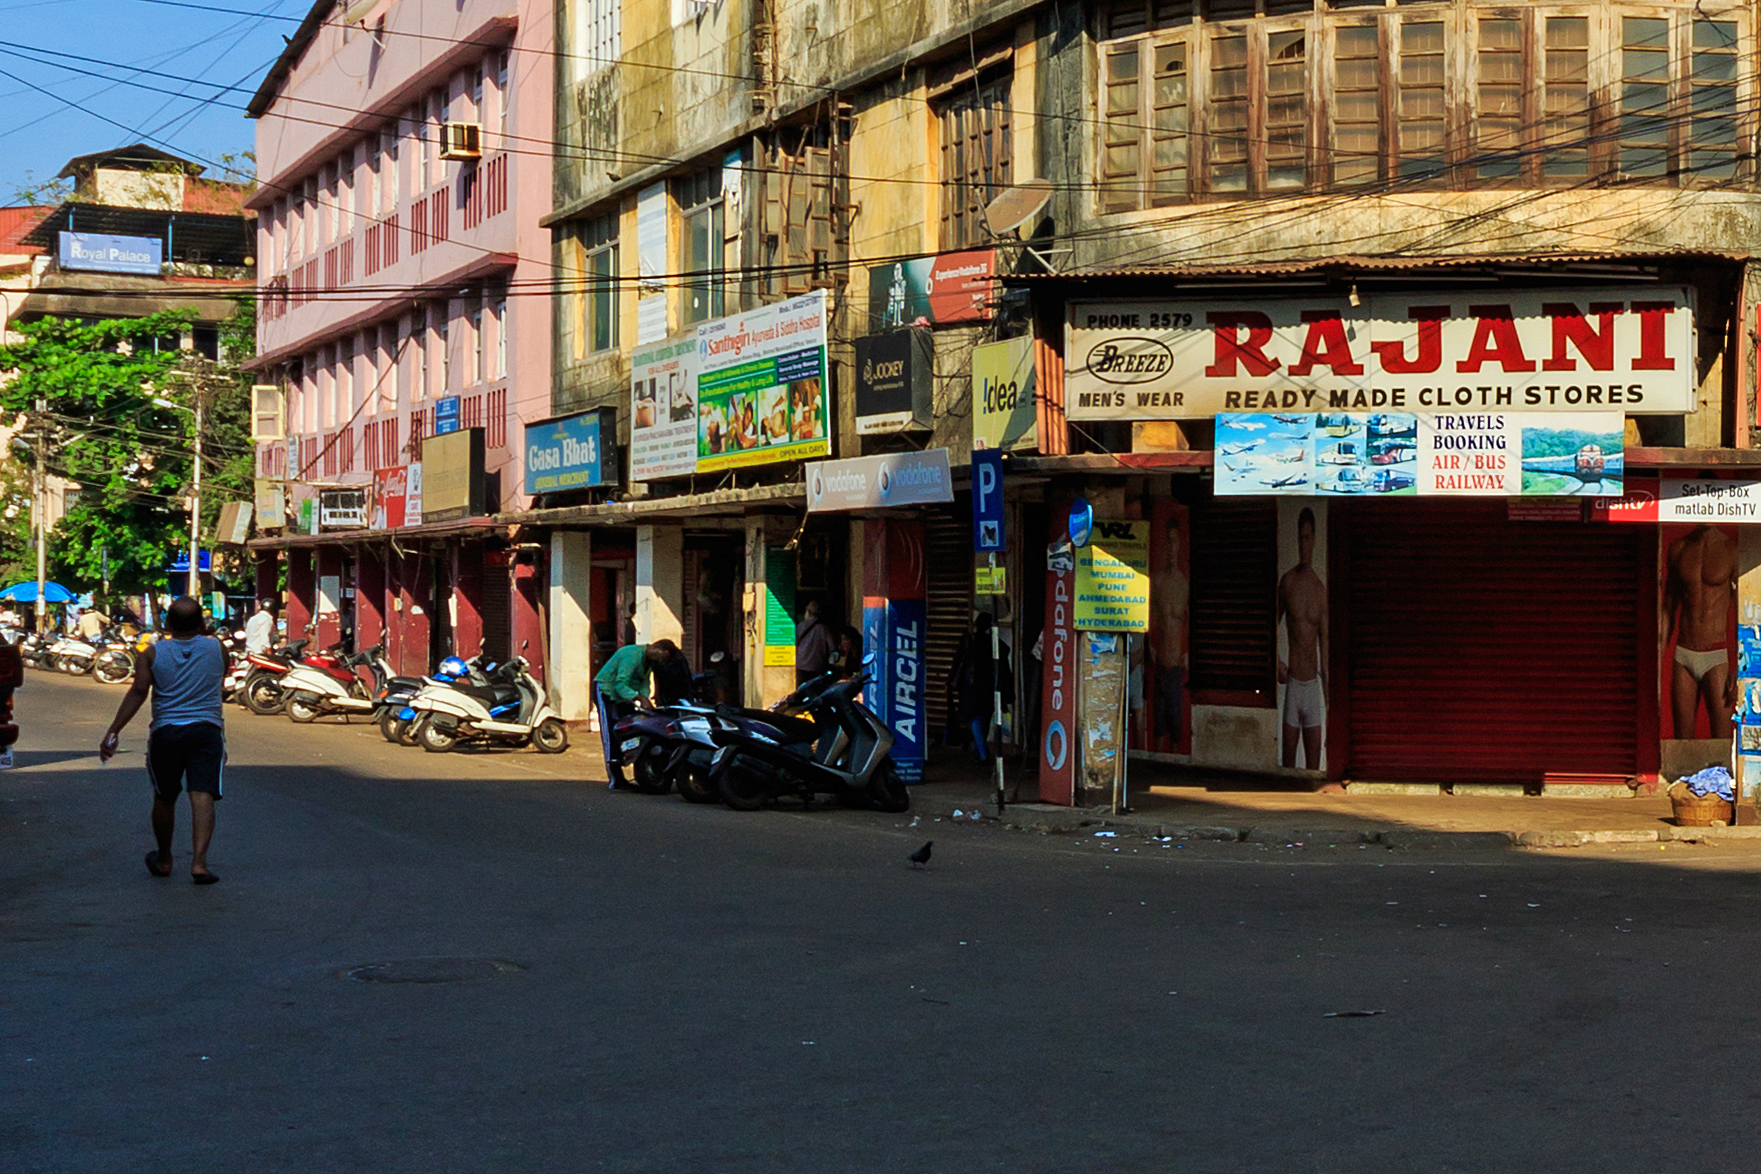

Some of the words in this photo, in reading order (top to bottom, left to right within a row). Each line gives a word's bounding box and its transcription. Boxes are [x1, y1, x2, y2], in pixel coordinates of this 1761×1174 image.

[70, 244, 106, 262] Royal
[109, 247, 151, 263] Palace
[1087, 314, 1139, 327] PHONE
[1150, 313, 1193, 327] 2579
[1205, 300, 1675, 378] RAJANI
[1094, 345, 1168, 373] BREEZE
[873, 360, 904, 379] JOCKEY
[1079, 390, 1125, 407] MEN'S
[1137, 392, 1184, 407] WEAR
[1225, 389, 1316, 408] READY
[1329, 388, 1405, 407] MADE
[1418, 386, 1512, 406] CLOTH
[1524, 384, 1643, 404] STORES
[1434, 415, 1504, 430] TRAVELS
[1433, 435, 1506, 450] BOOKING
[562, 435, 596, 467] Bhat
[780, 448, 796, 458] OPEN
[1432, 454, 1460, 469] AIR
[1474, 454, 1506, 469] BUS
[825, 469, 867, 493] vodafone
[894, 462, 942, 486] vodafone
[1435, 474, 1504, 489] RAILWAY
[979, 462, 996, 513] P
[1681, 484, 1750, 499] Set-Top-Box
[1675, 503, 1715, 516] matlab
[1718, 503, 1757, 516] DishTV
[1091, 571, 1134, 579] MUMBAI
[1098, 583, 1127, 591] PUNE
[1078, 594, 1146, 603] AHMEDABAD
[1094, 607, 1130, 615] SURAT
[1078, 619, 1145, 627] HYDERABAD
[1053, 569, 1068, 711] dafone
[869, 620, 878, 715] IRCEL
[895, 621, 917, 743] AIRCEL
